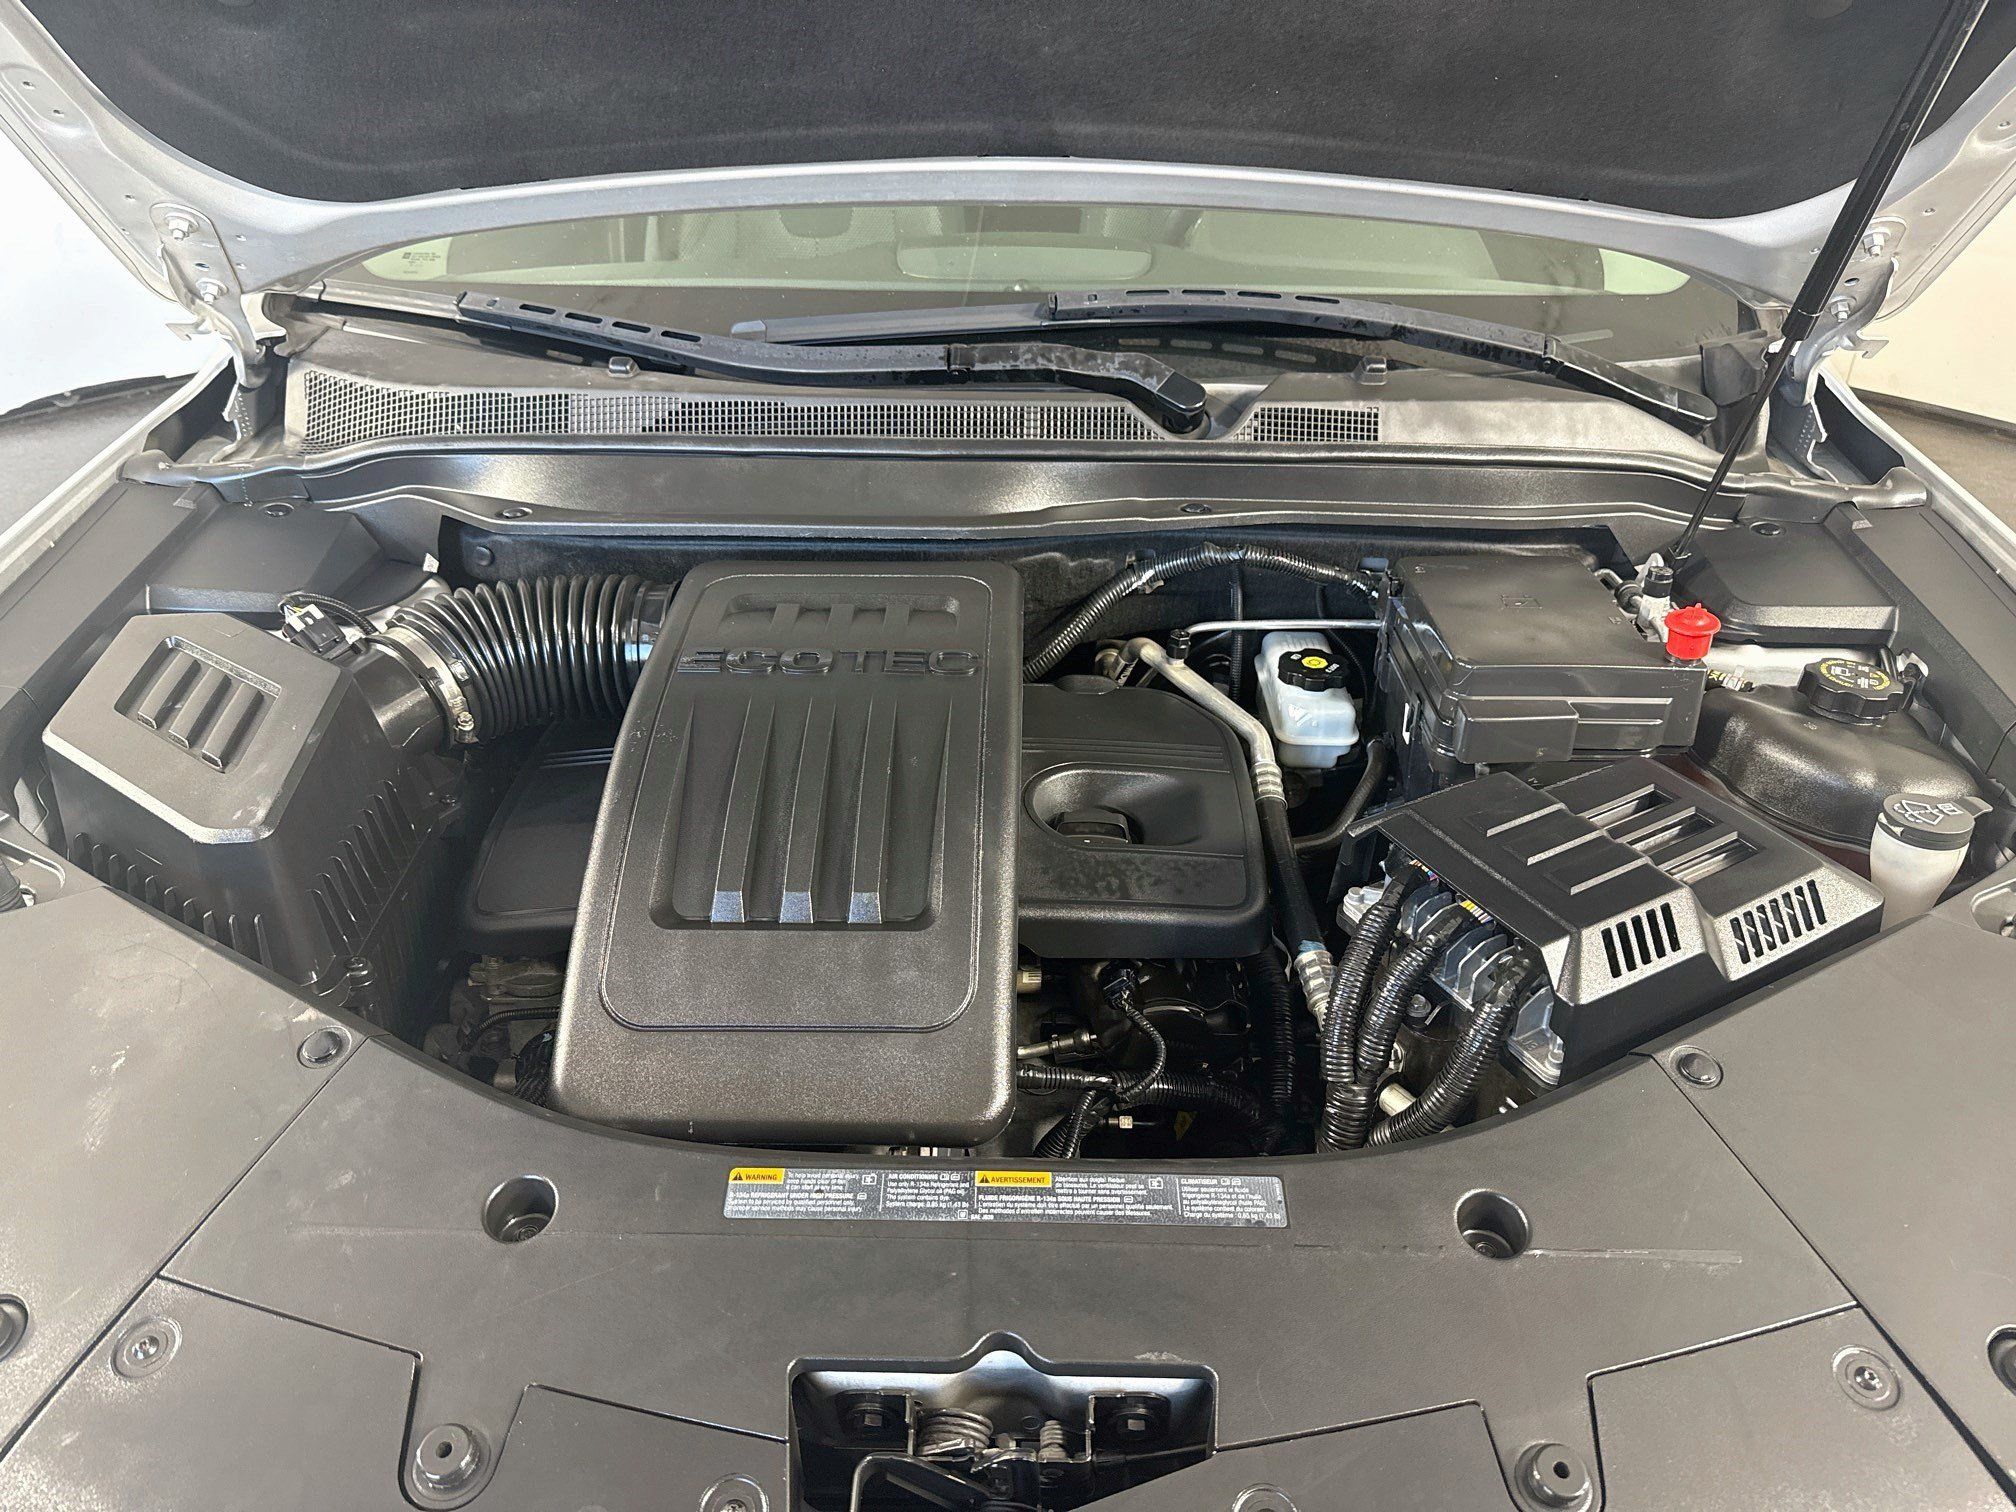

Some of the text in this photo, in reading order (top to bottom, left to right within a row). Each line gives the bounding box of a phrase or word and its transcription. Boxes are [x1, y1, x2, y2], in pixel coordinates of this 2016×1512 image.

[677, 648, 981, 676] ECOTEC
[745, 1173, 778, 1181] WARNING
[990, 1176, 1046, 1184] AVERTISSEMENT
